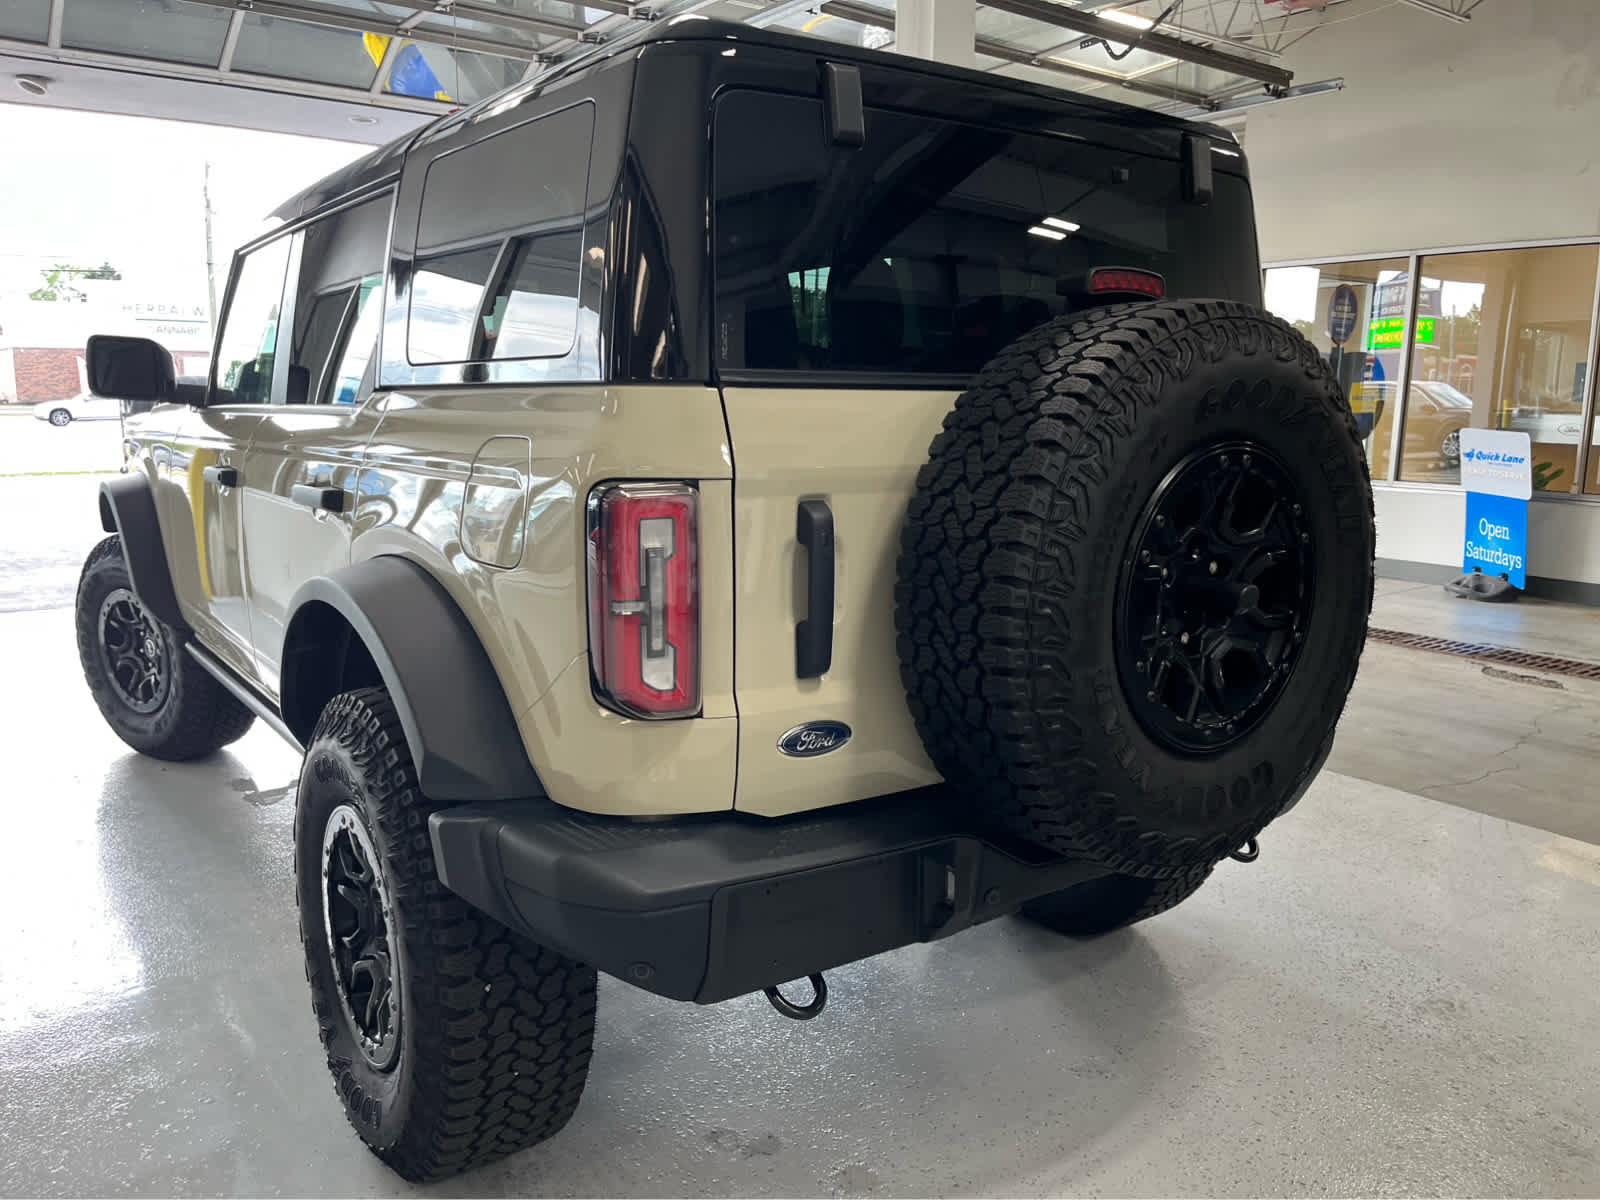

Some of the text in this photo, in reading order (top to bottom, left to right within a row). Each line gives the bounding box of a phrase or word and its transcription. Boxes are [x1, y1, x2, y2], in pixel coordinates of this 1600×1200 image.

[1476, 450, 1500, 461] Quick
[1502, 453, 1525, 464] Lane
[1479, 518, 1509, 540] Open
[1466, 542, 1522, 570] Saturdays
[796, 730, 837, 751] Ford
